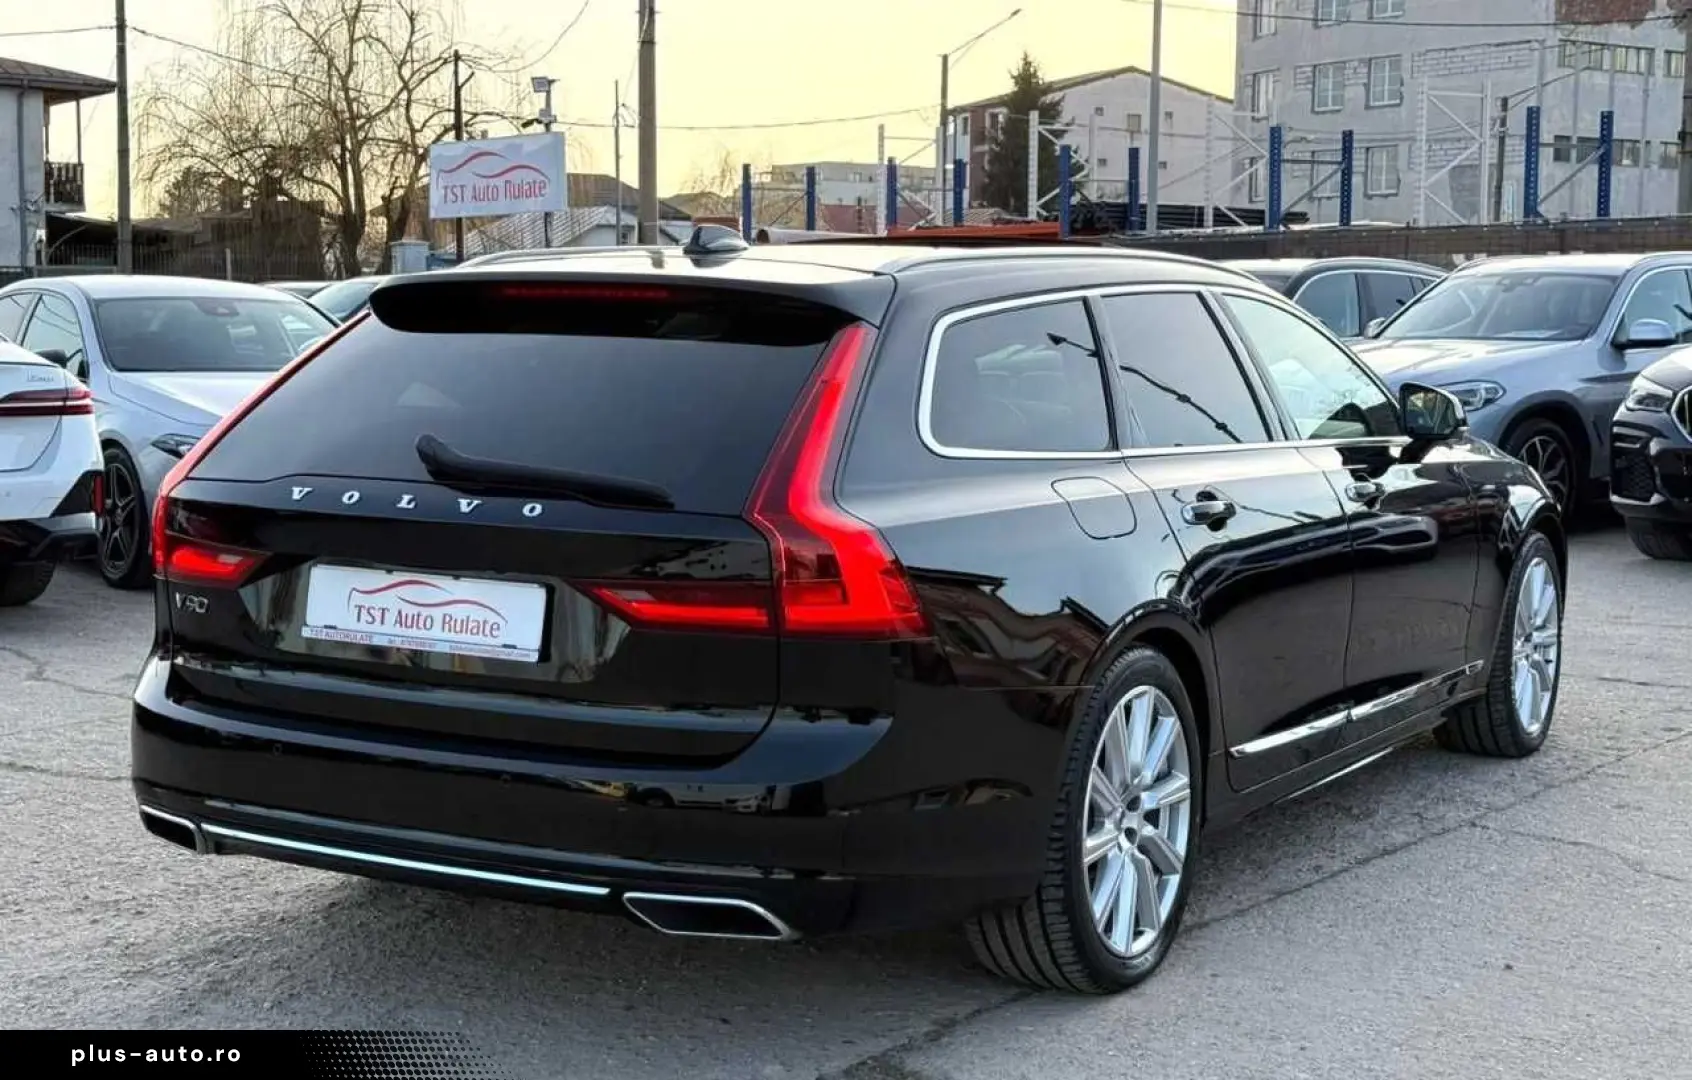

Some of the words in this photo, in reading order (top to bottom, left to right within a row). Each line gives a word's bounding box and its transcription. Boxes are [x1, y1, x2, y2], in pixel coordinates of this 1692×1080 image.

[442, 184, 466, 204] TST
[471, 181, 499, 202] Auto
[504, 179, 547, 201] Rulate
[291, 486, 543, 518] VOLVO
[175, 591, 209, 613] V90
[354, 604, 390, 626] TST
[393, 609, 434, 631] Auto
[441, 612, 501, 639] Rulate
